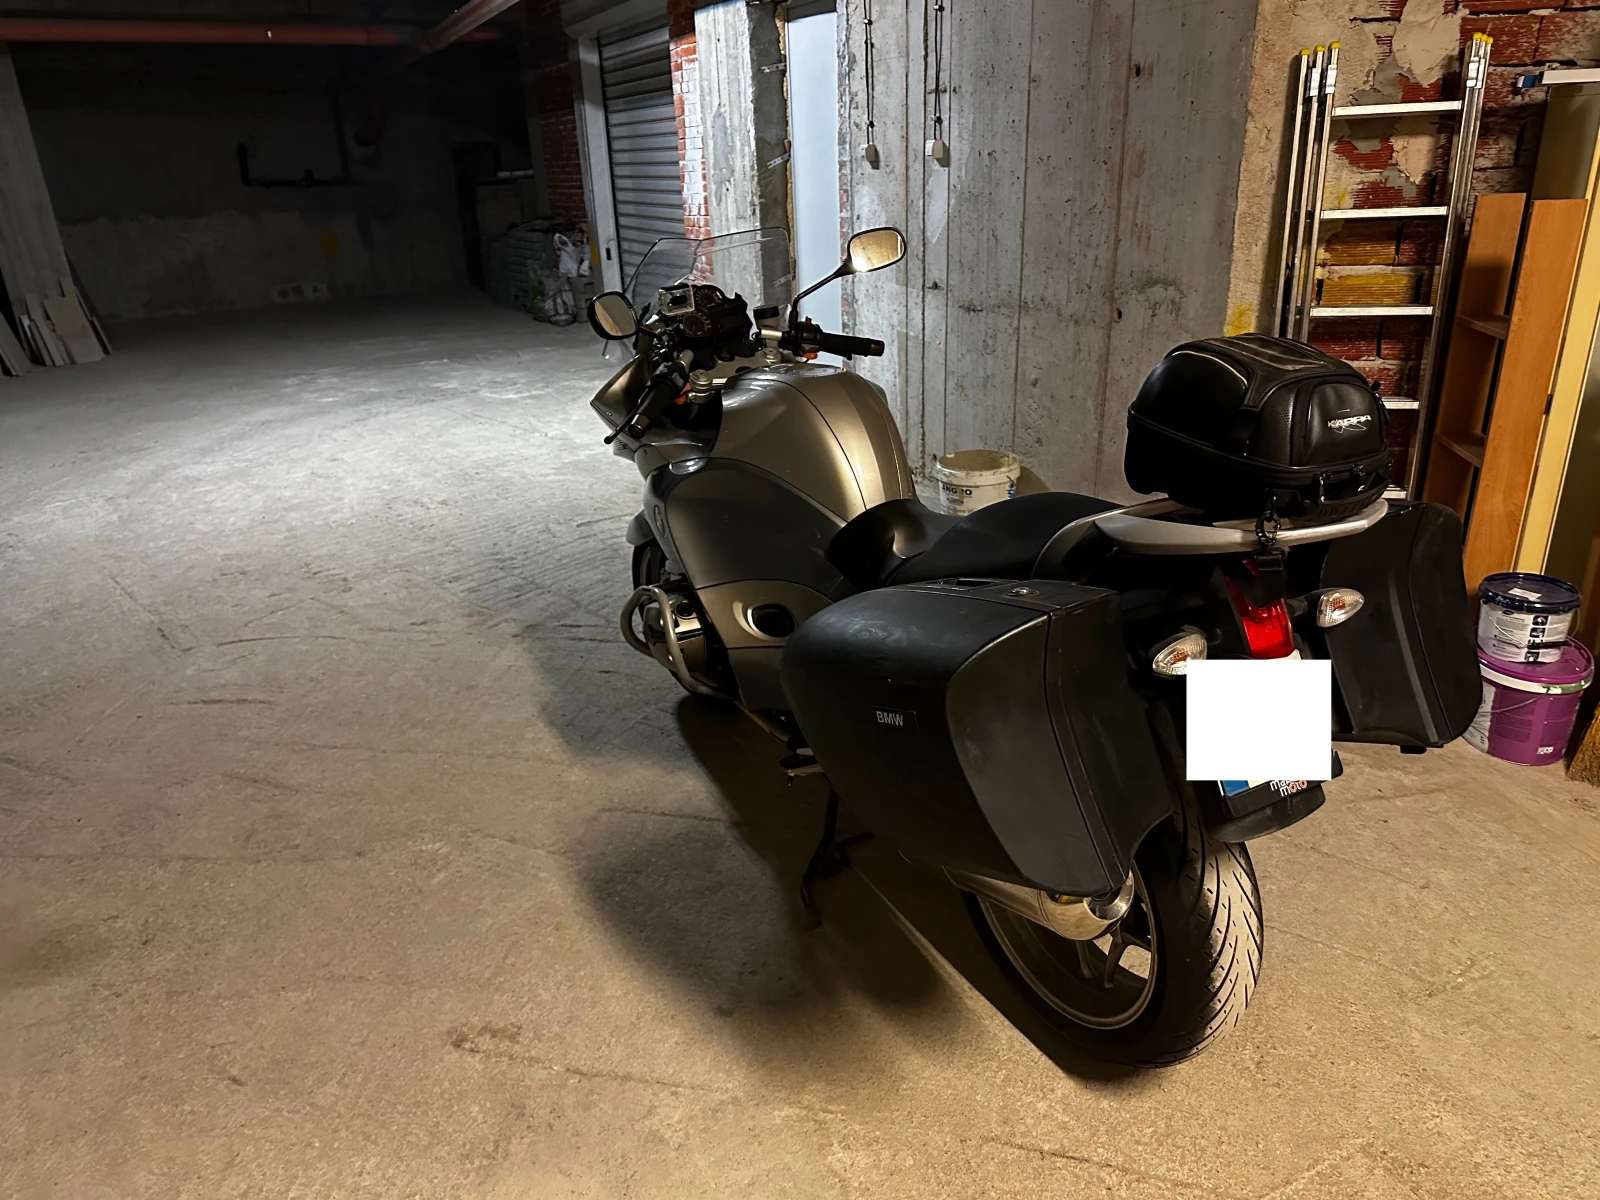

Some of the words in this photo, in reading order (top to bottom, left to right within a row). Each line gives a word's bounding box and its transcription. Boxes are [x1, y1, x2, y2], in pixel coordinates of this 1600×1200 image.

[1327, 414, 1372, 428] KAPPA
[876, 710, 904, 727] BMW
[1280, 780, 1308, 797] moto
